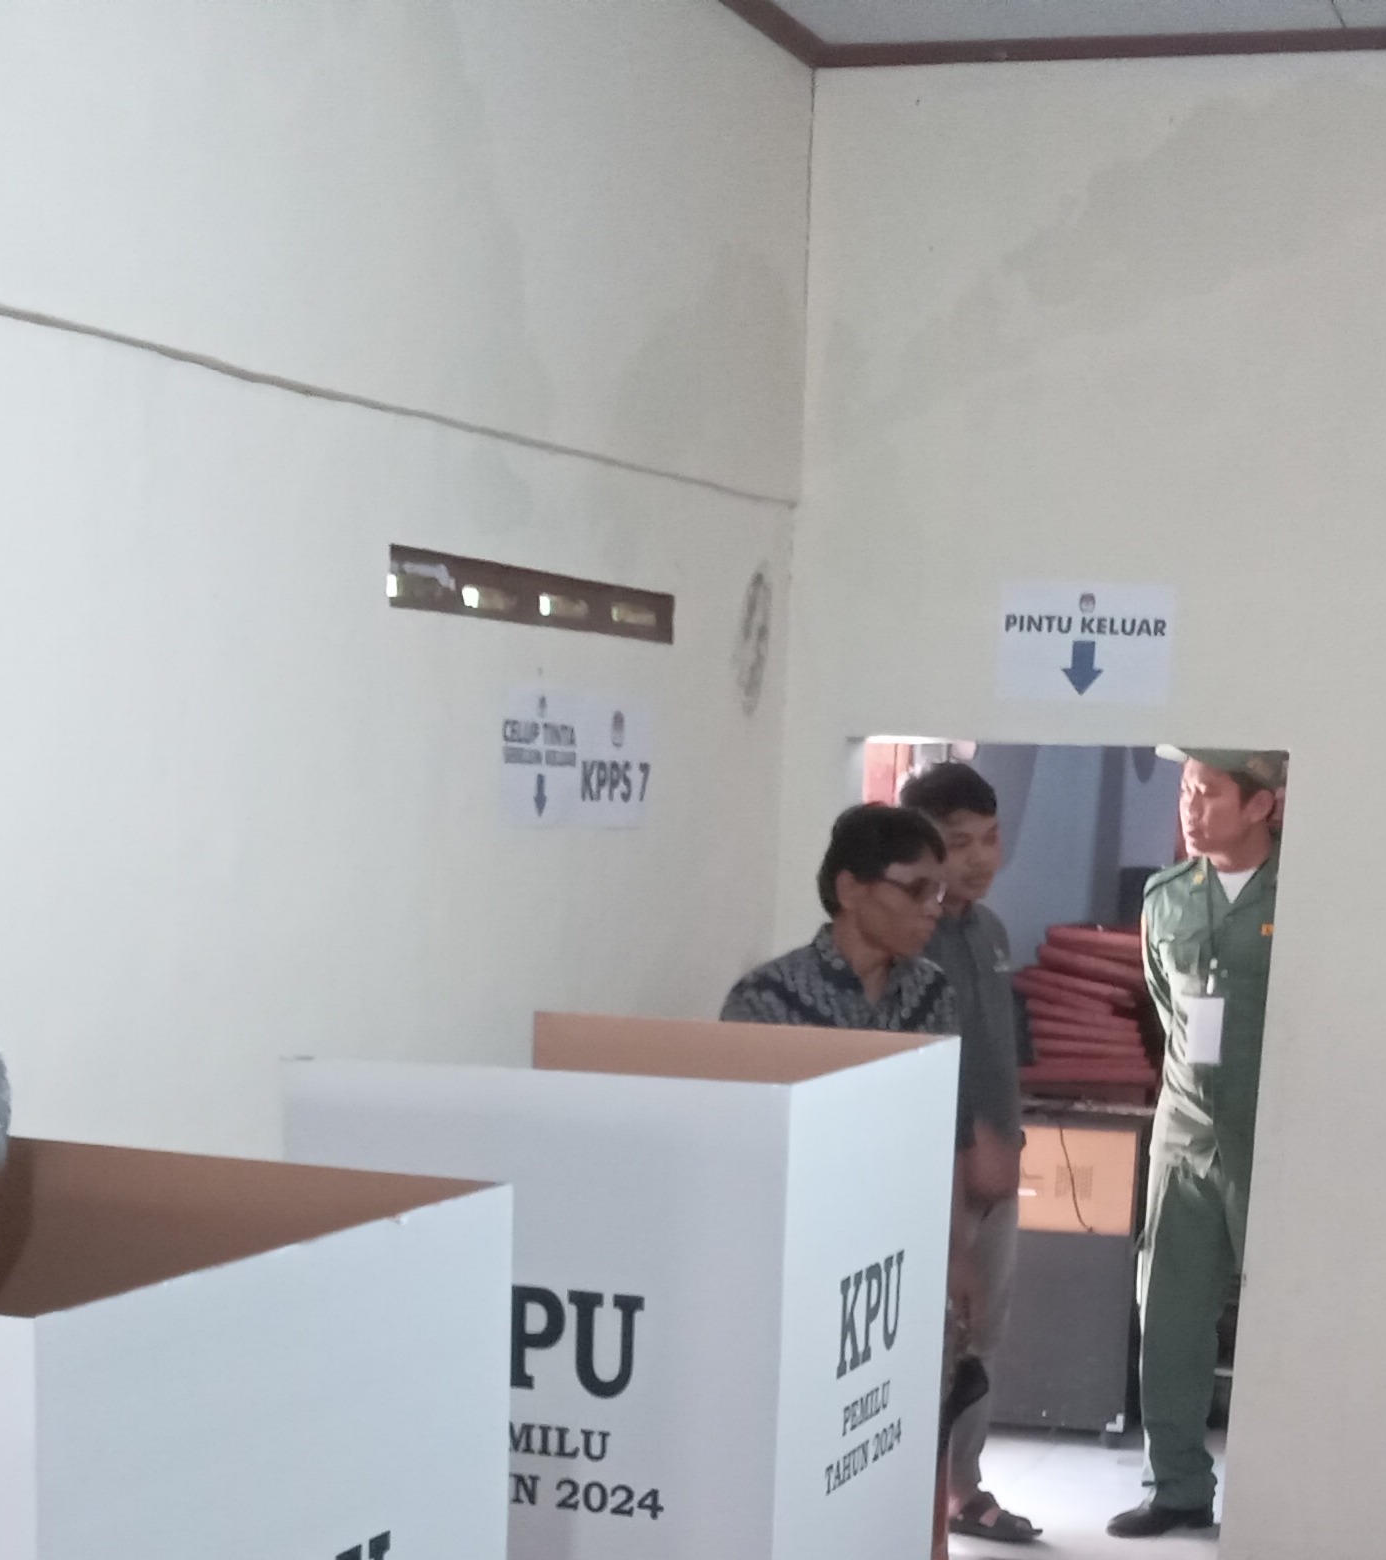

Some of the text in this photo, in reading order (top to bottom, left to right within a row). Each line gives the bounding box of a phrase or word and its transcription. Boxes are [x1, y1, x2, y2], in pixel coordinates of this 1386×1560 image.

[1005, 614, 1166, 637] PINTU KELUAR
[581, 760, 650, 803] KPPS 7
[836, 1249, 904, 1380] KPU
[510, 1285, 644, 1399] PU
[842, 1380, 890, 1437] PEMILU
[509, 1420, 611, 1462] MILU
[825, 1417, 902, 1496] TAHUN 2024
[556, 1477, 664, 1520] 2024
